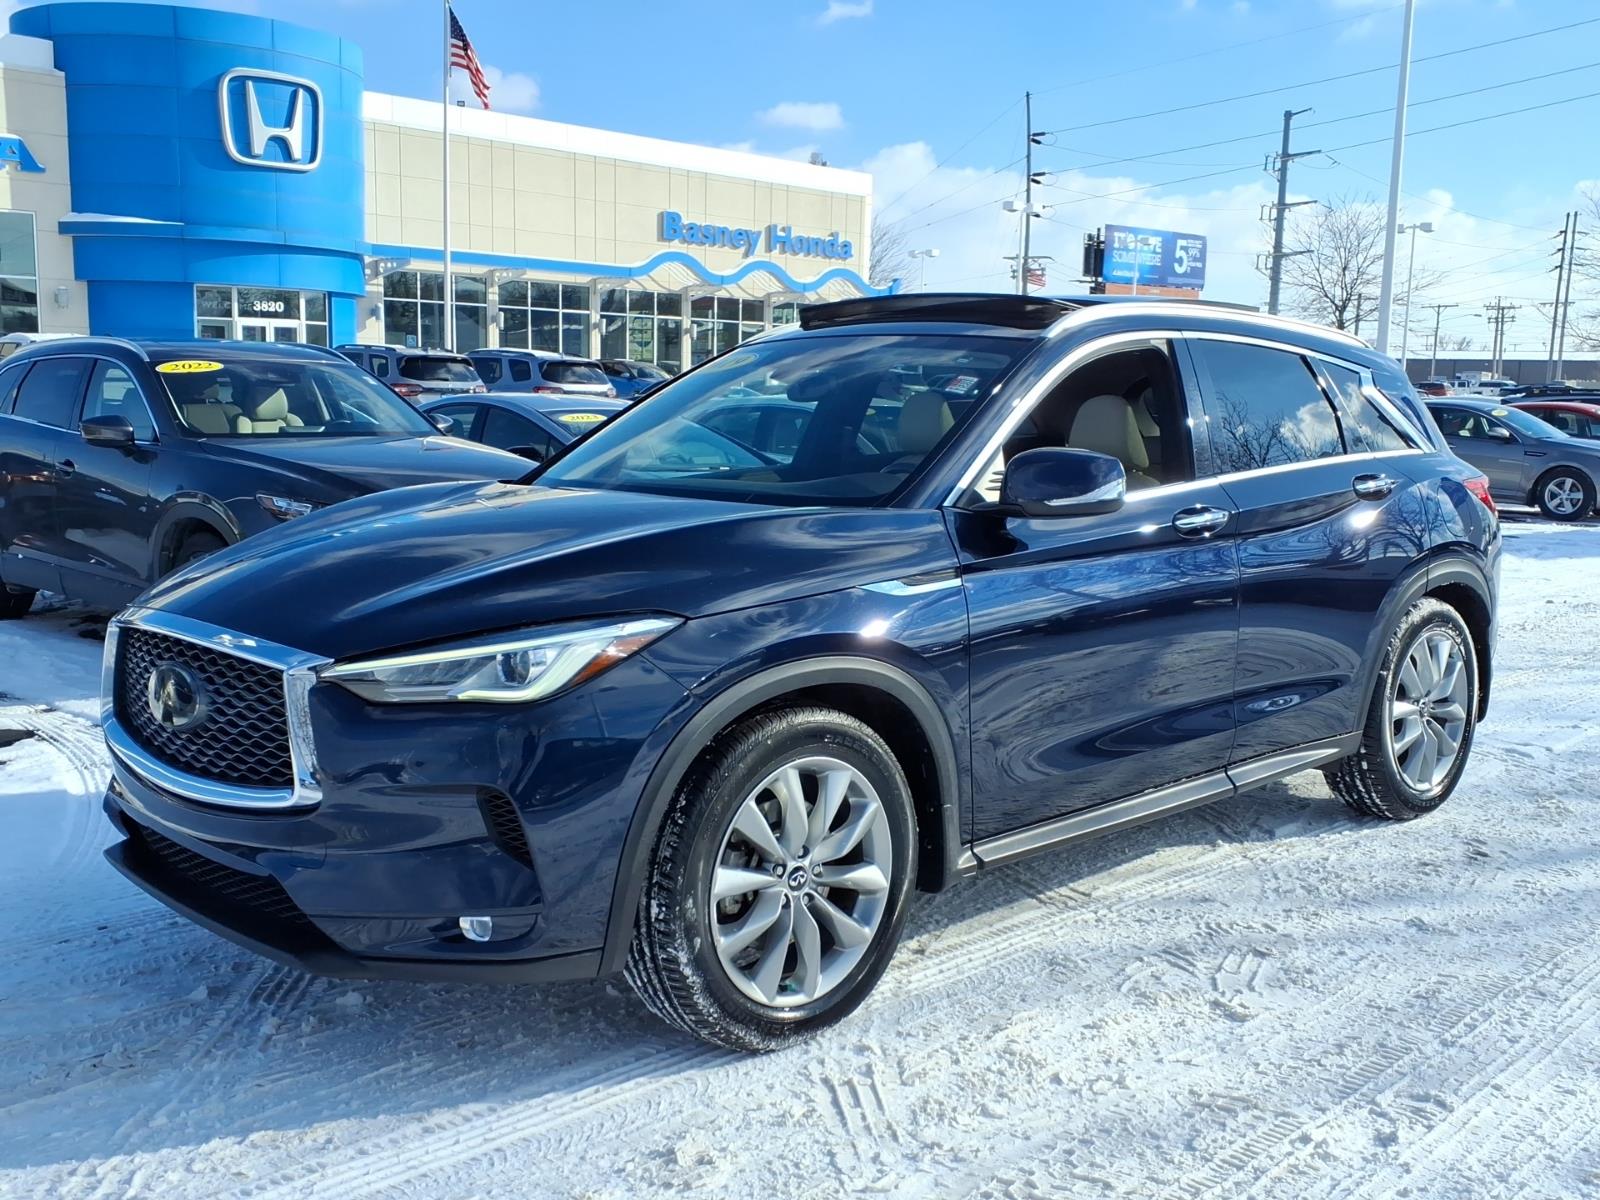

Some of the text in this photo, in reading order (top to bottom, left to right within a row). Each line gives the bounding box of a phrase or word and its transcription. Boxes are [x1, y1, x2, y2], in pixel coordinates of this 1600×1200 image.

[657, 210, 853, 260] Basney Honda
[1173, 239, 1188, 274] 5
[252, 300, 285, 313] 3820
[170, 362, 213, 371] 2022
